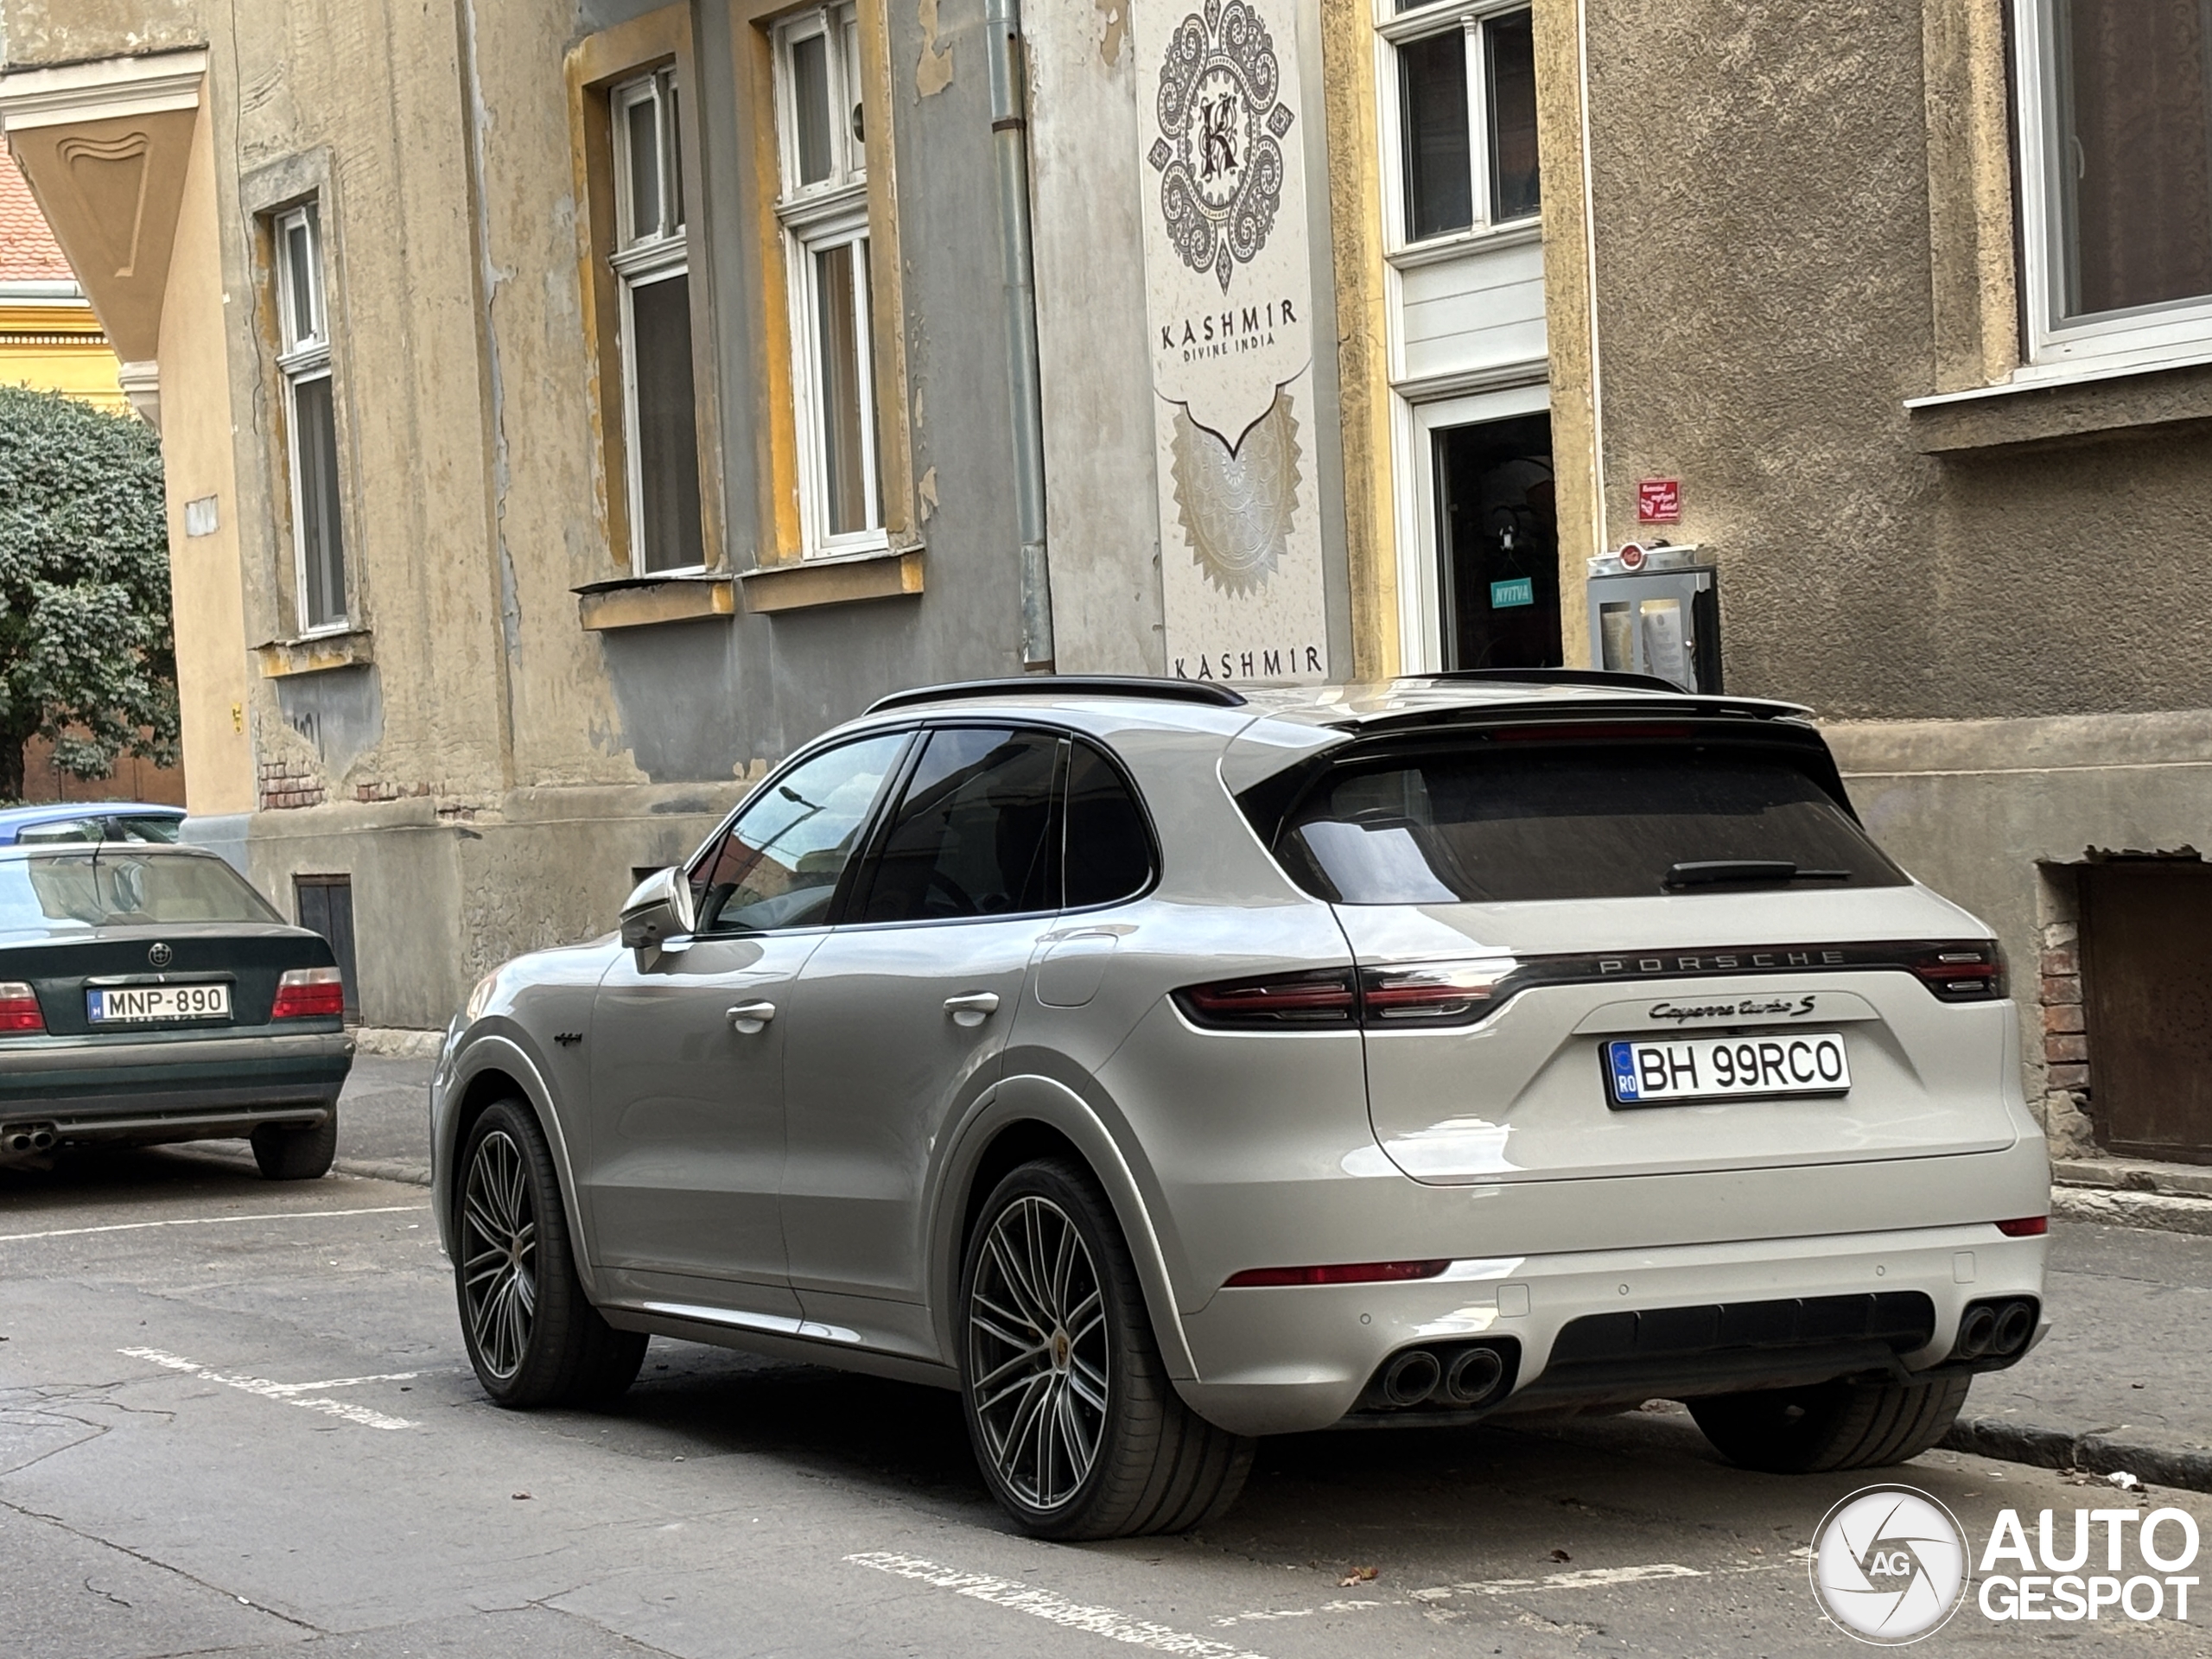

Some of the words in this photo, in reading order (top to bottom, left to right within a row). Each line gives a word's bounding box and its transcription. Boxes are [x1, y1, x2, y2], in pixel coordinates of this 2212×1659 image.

[1161, 299, 1297, 350] KASHMIR
[1184, 342, 1228, 362] DIVINE
[1235, 332, 1274, 353] INDIA
[1175, 646, 1322, 680] KASHMIR
[1599, 951, 1844, 975] PORSCHE
[109, 988, 222, 1016] MNP-890
[1649, 1002, 1735, 1026] Cayenne
[1789, 995, 1816, 1017] S
[1637, 1046, 1700, 1092] BH
[1712, 1040, 1842, 1088] 99RCO
[1618, 1075, 1637, 1093] RO
